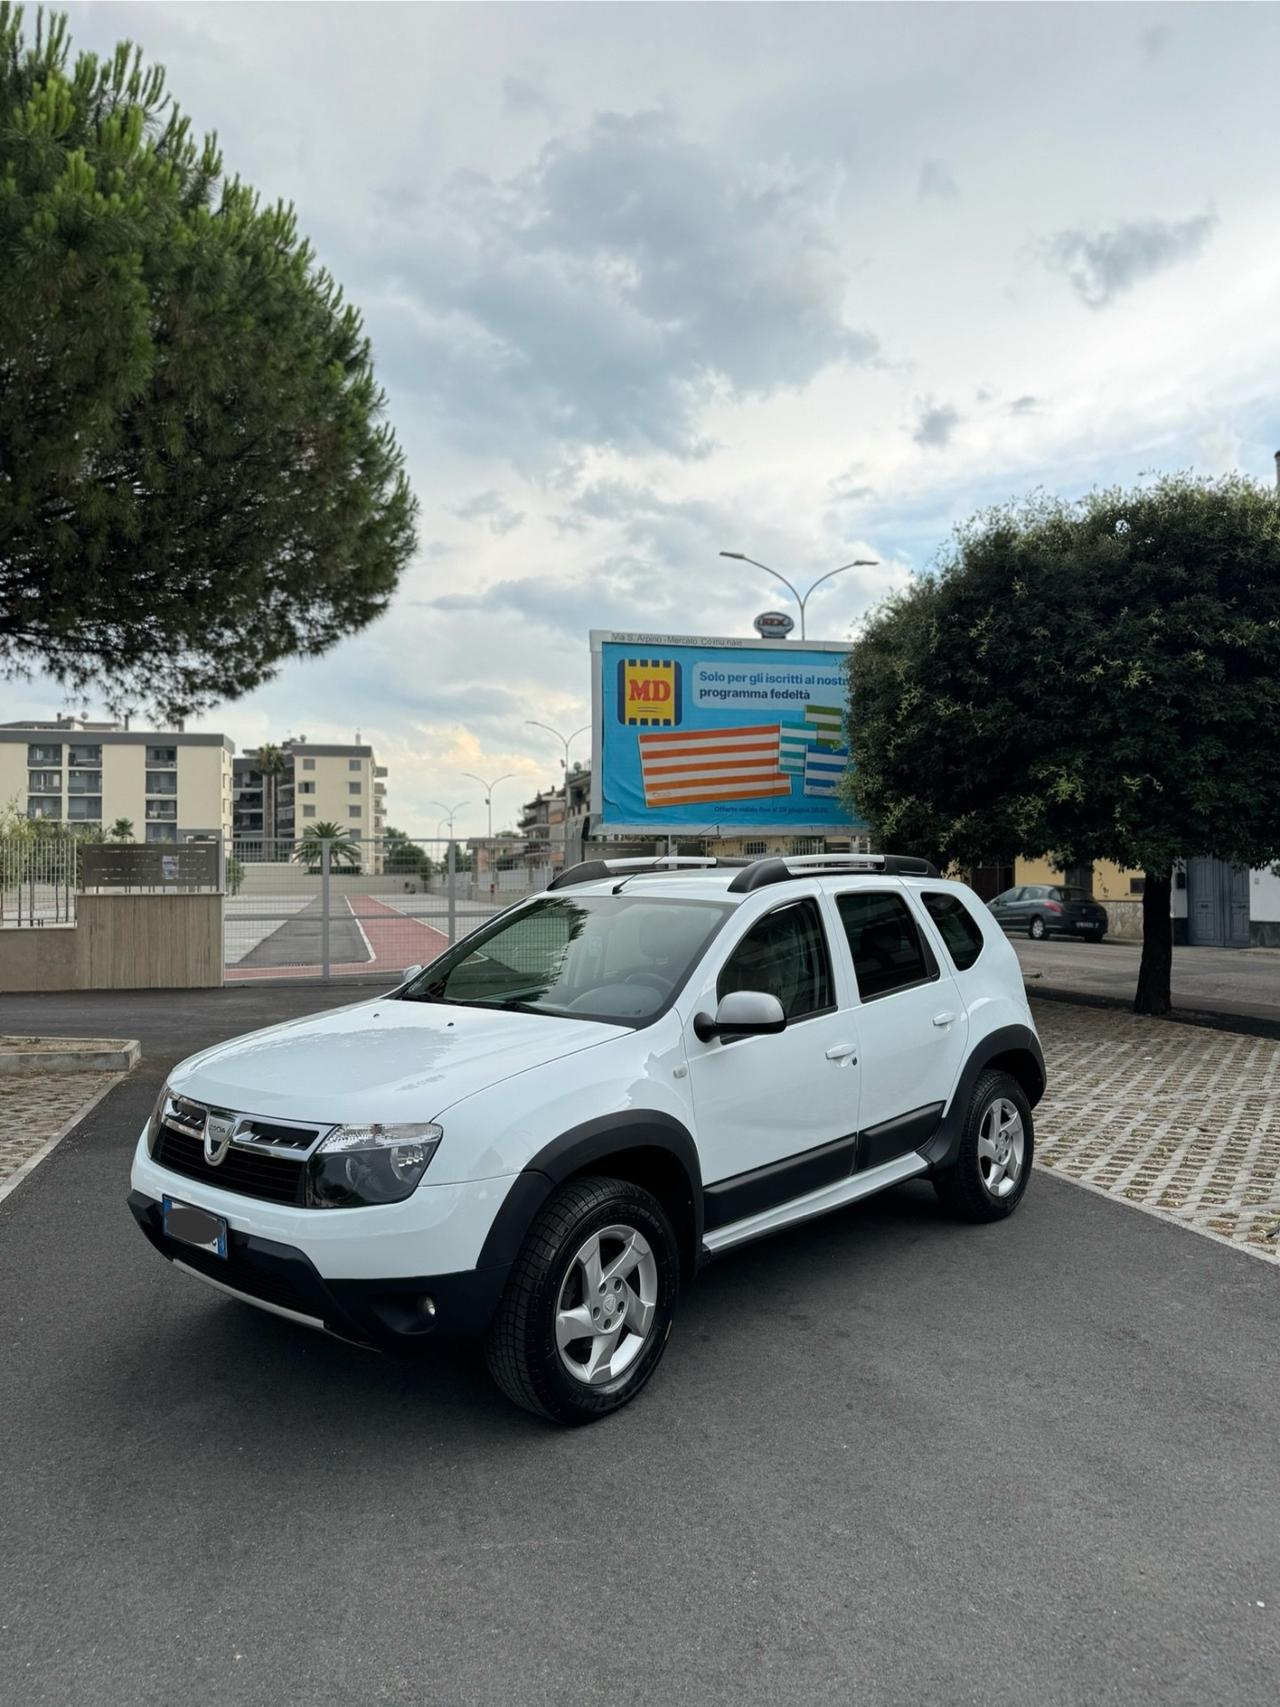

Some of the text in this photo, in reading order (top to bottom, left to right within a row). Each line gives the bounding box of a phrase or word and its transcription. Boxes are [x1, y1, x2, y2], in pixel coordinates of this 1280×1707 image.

[611, 632, 625, 641] Via
[699, 671, 850, 687] Solo per gli iscritti al nostr
[629, 679, 671, 701] MD
[699, 688, 811, 700] programma fedeltà
